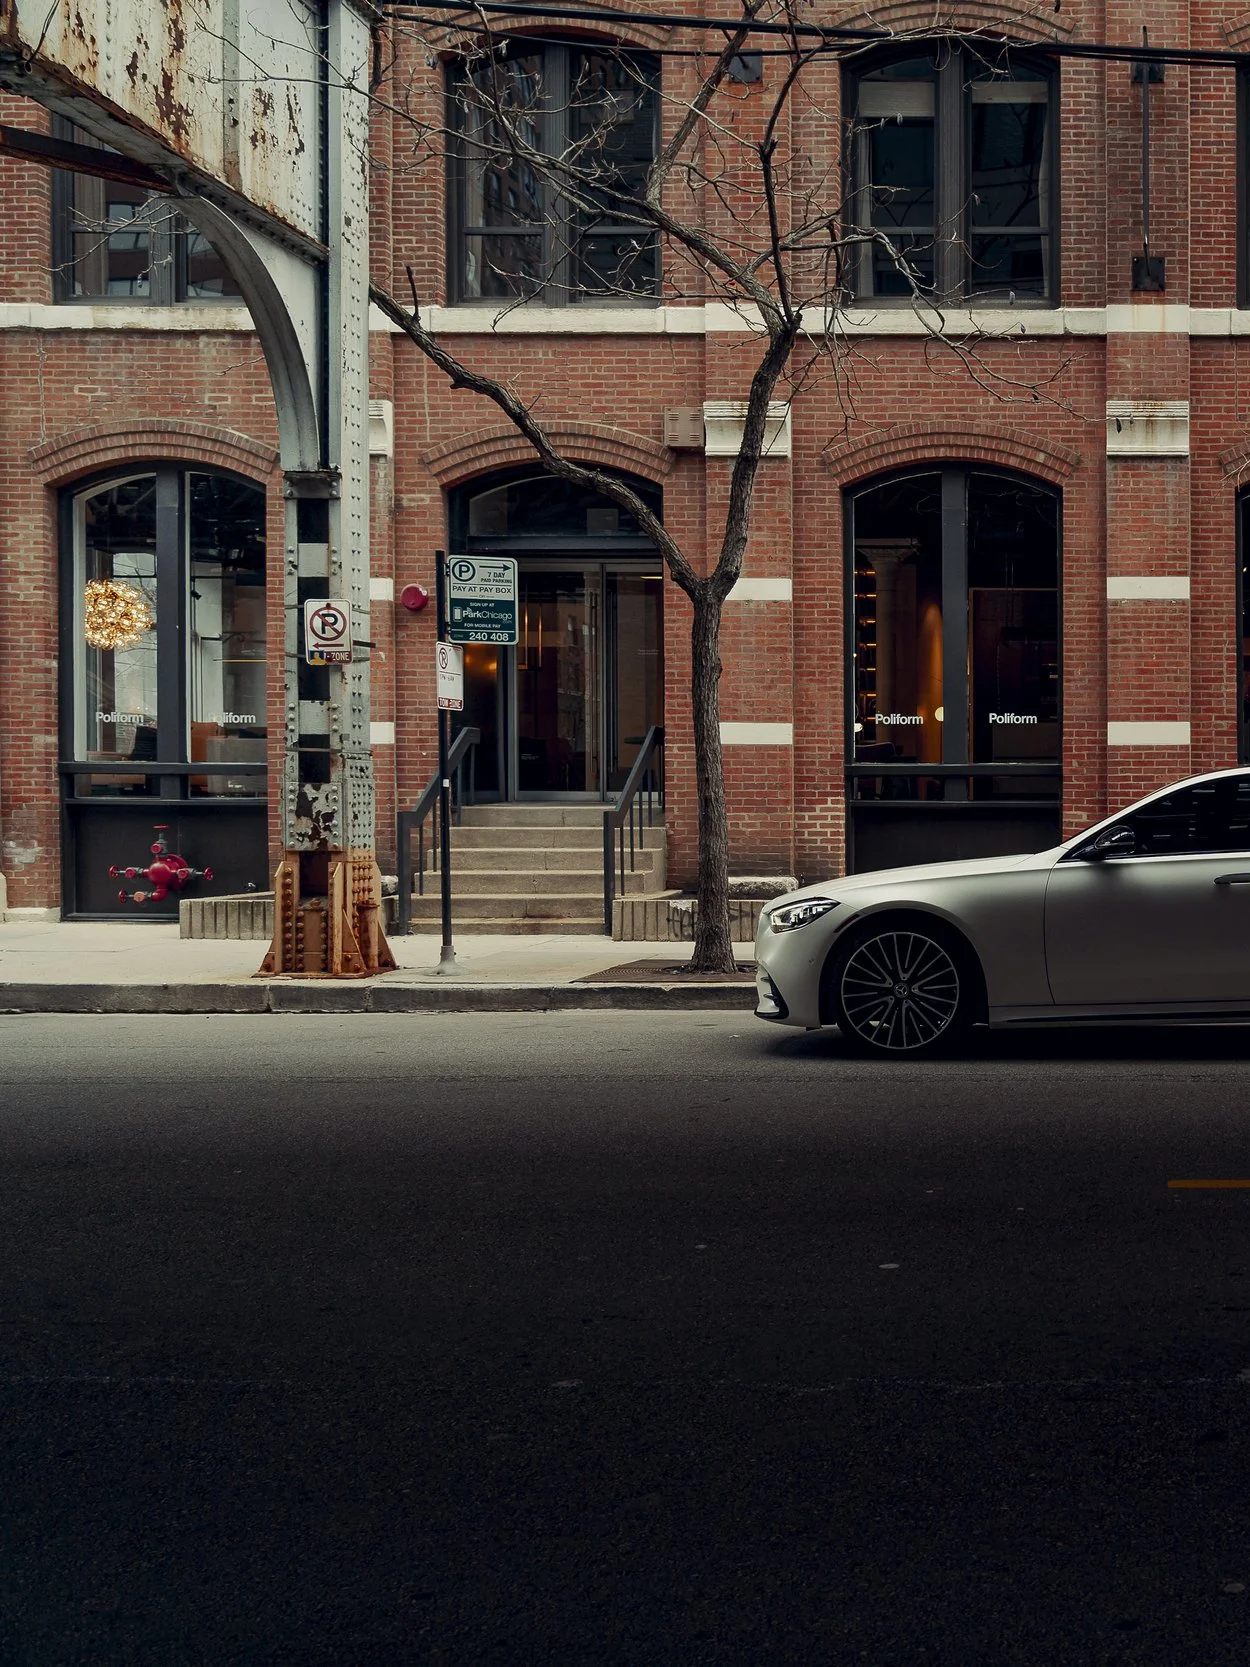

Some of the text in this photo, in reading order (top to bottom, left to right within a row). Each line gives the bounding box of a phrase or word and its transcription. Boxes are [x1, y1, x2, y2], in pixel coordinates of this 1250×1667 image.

[458, 564, 470, 577] P
[462, 610, 512, 620] ParkChicago
[469, 632, 488, 640] 240
[490, 633, 509, 641] 408
[95, 711, 144, 723] Poliform
[875, 713, 923, 724] Poliform
[989, 712, 1038, 724] Poliform
